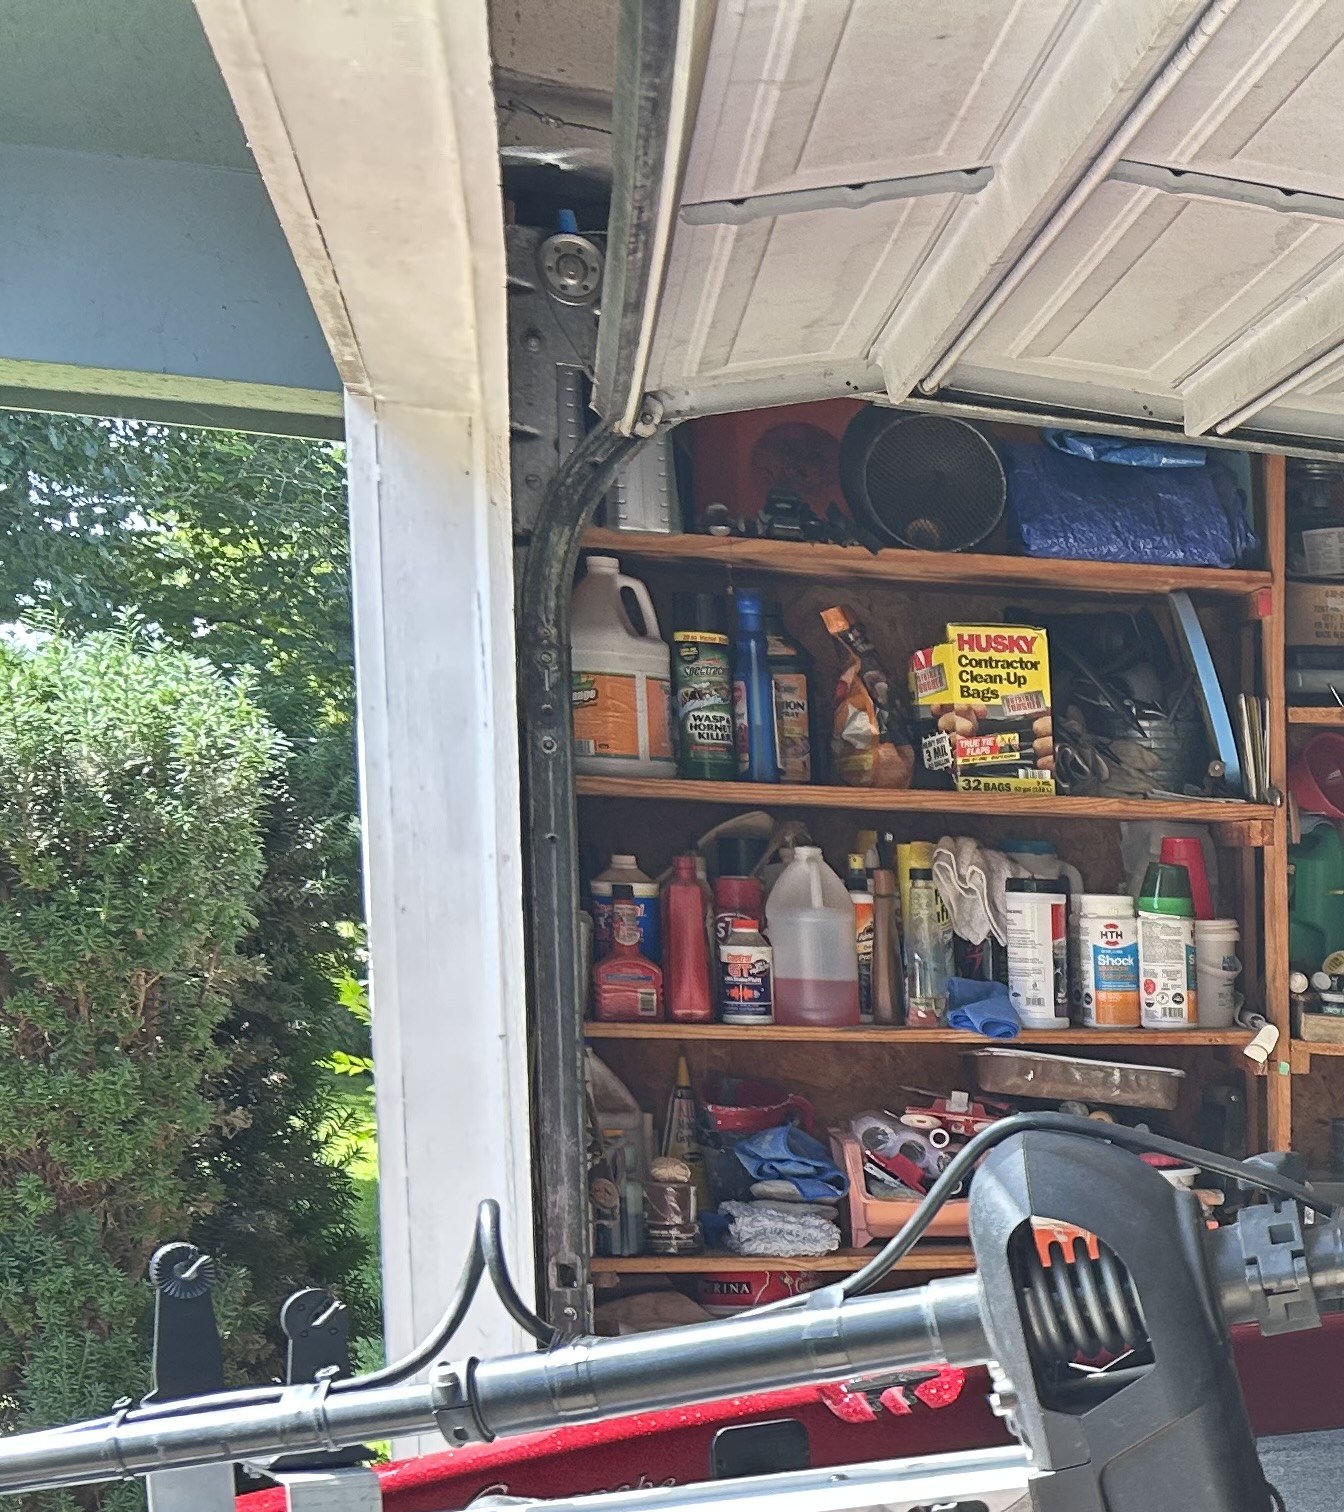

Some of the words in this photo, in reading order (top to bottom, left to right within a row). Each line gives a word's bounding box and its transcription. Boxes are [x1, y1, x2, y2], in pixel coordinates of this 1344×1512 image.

[957, 633, 1038, 654] HUSKY
[958, 655, 1040, 671] Contractor
[958, 670, 1027, 688] Clean-Up
[960, 685, 999, 702] Bags
[692, 714, 724, 723] WASP
[962, 779, 982, 791] 32
[984, 781, 1011, 793] BAGS
[1100, 931, 1123, 940] HTH
[1097, 954, 1135, 966] Shock
[706, 1283, 750, 1294] RINA
